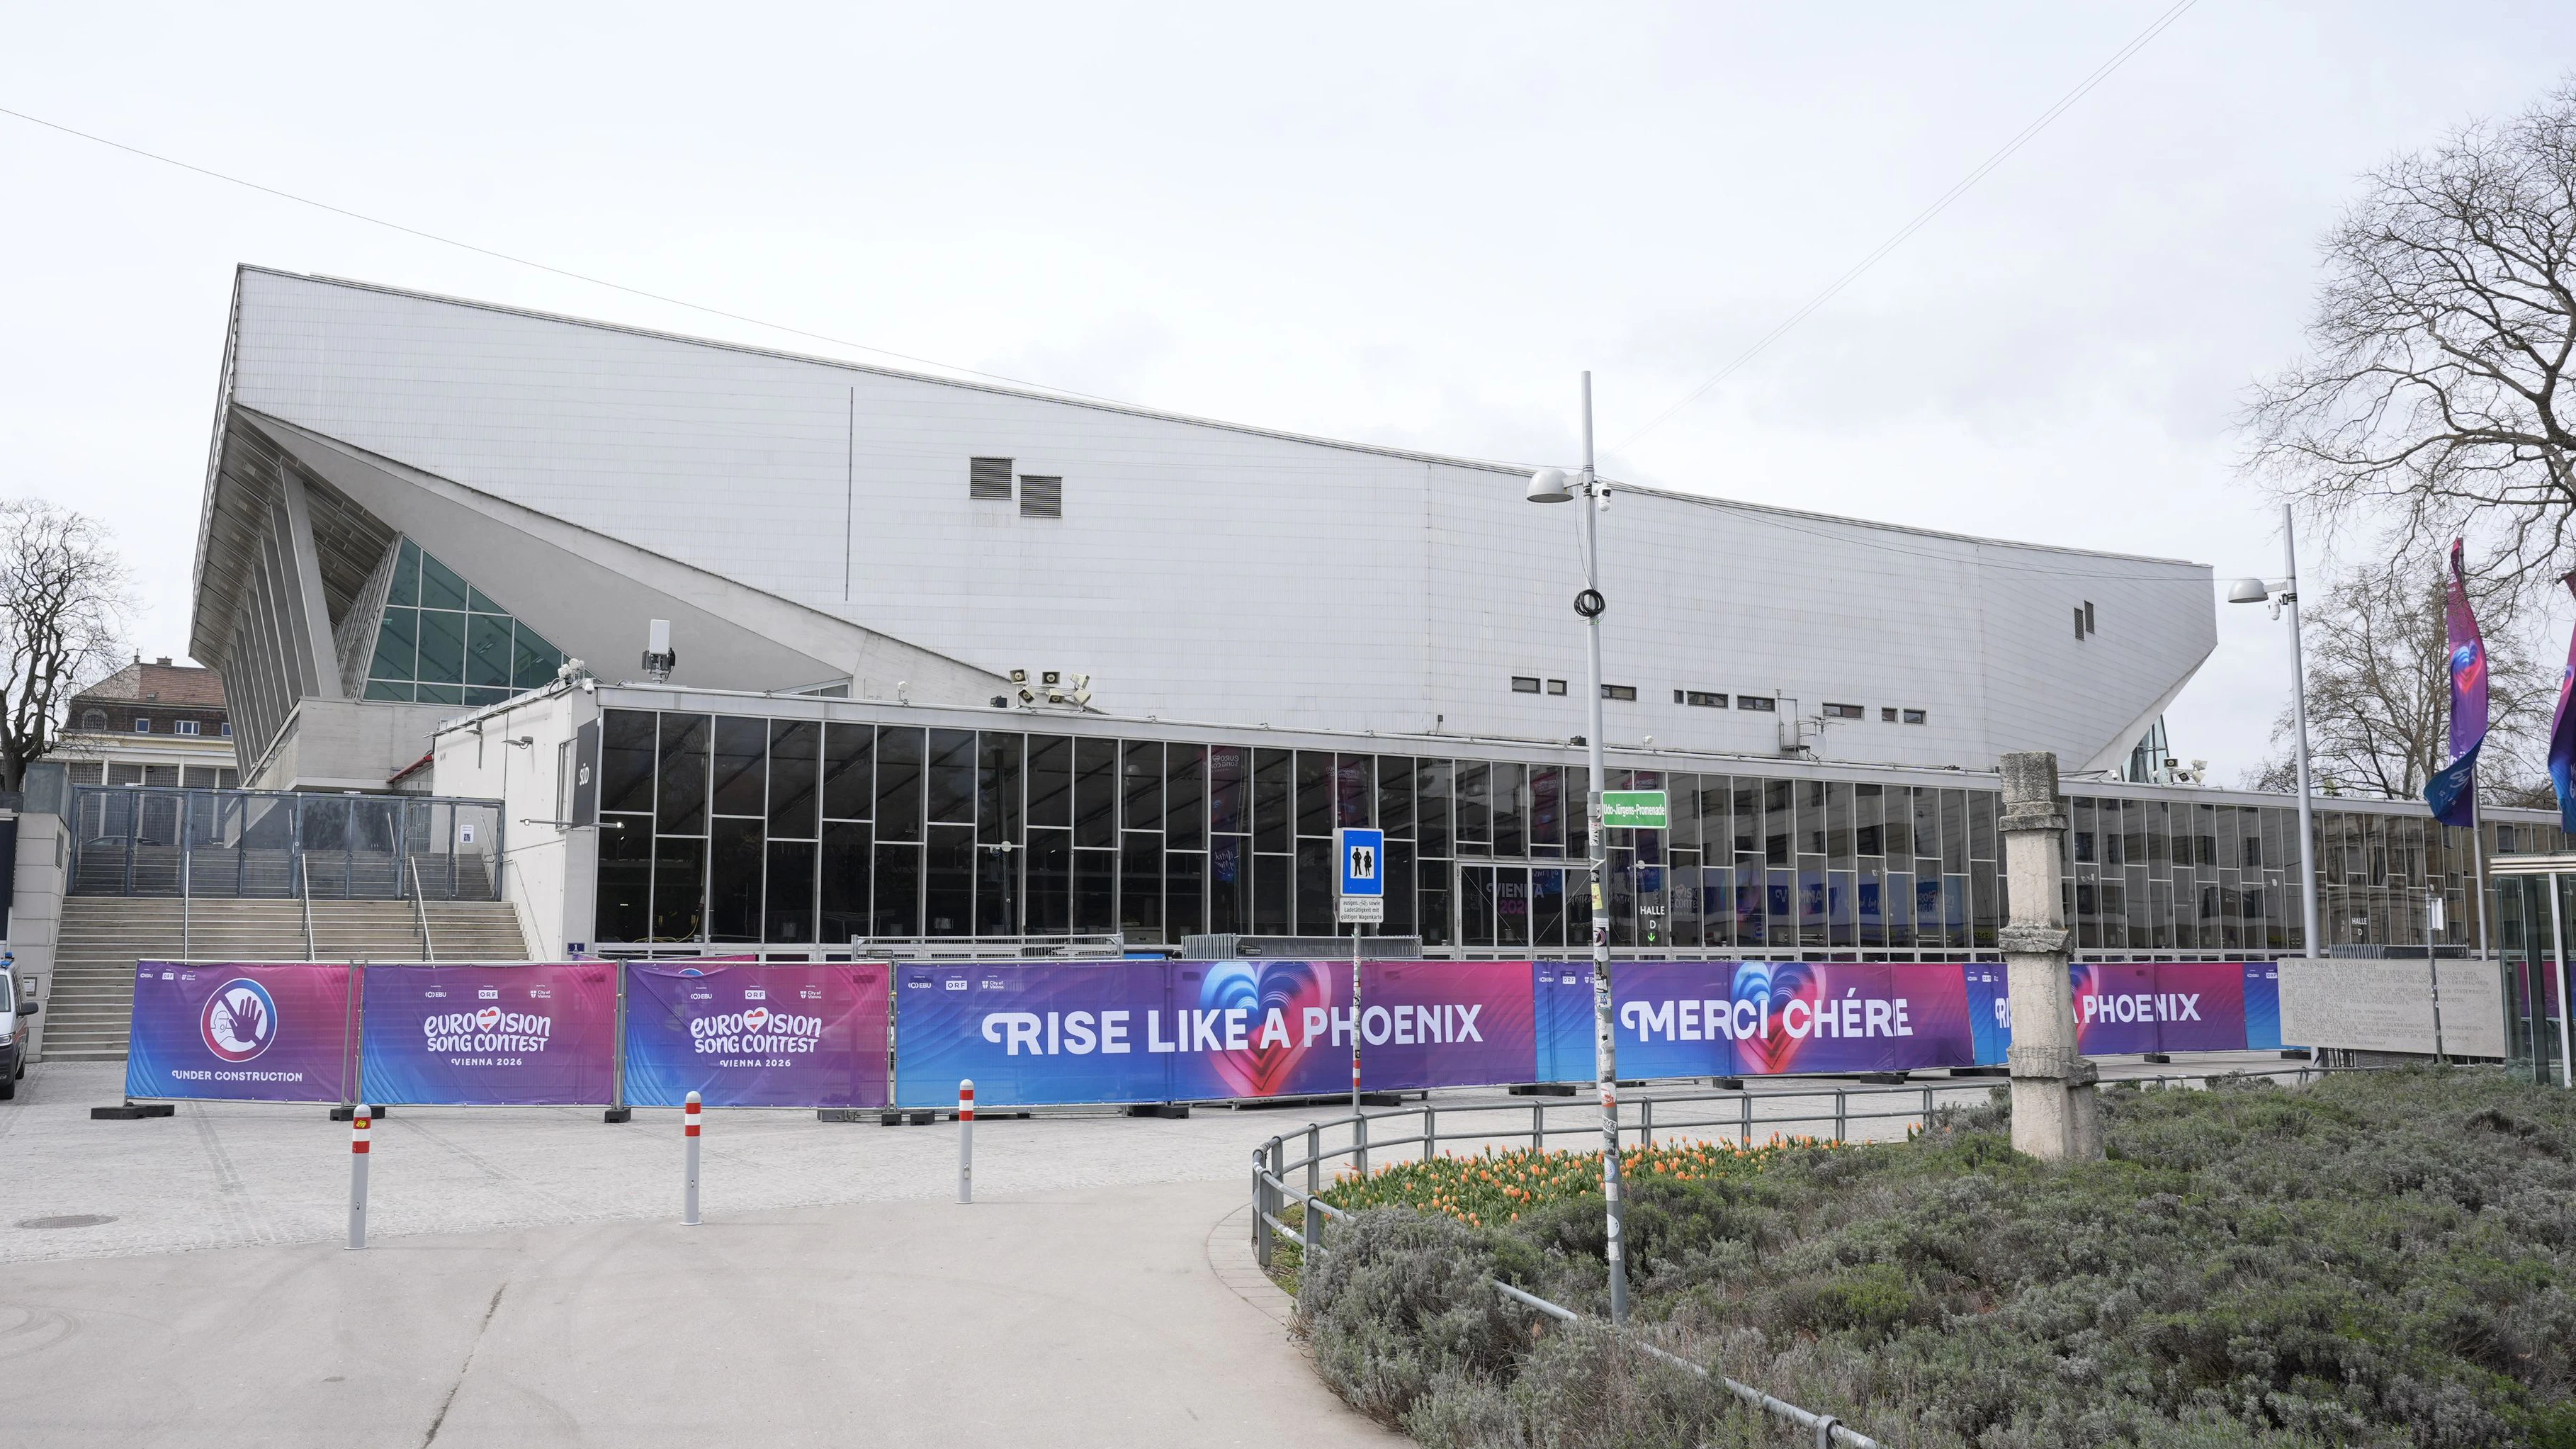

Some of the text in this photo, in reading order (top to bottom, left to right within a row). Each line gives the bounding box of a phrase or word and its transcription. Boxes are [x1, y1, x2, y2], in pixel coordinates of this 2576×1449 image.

[579, 762, 589, 786] SÜD
[1603, 804, 1666, 817] Udo-Jürgens-Promenade
[1640, 906, 1665, 915] HALLE
[1649, 920, 1656, 929] D
[1994, 993, 2202, 1030] RI PHOENIX
[1620, 998, 1768, 1043] MERCI
[981, 1003, 1484, 1056] RISE LIKE A PHOENIX
[720, 1059, 762, 1068] VIENNA
[171, 1070, 303, 1082] UNDER CONSTRUCTION
